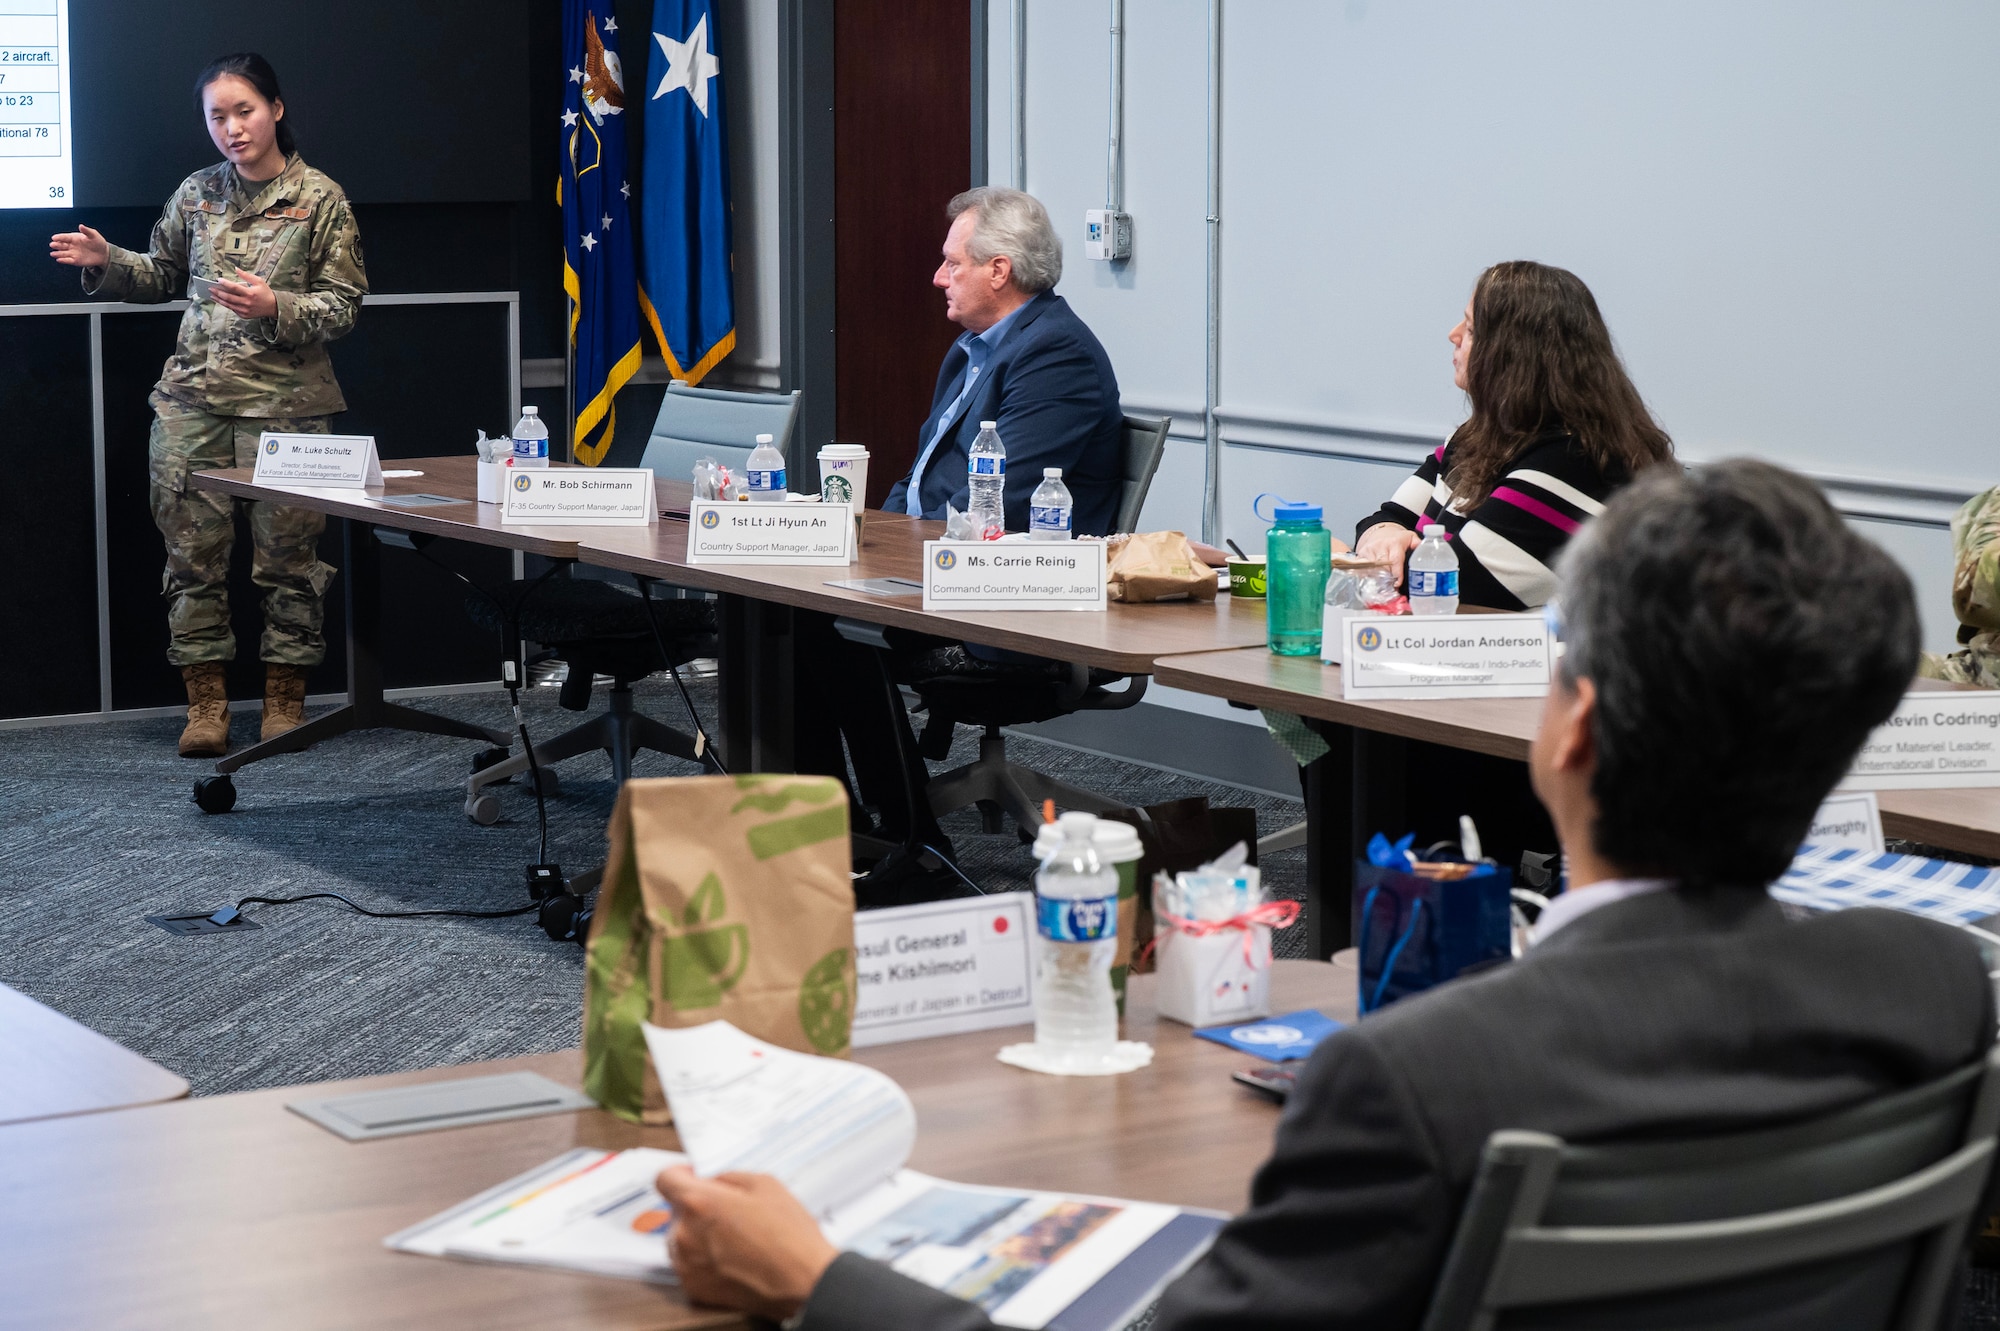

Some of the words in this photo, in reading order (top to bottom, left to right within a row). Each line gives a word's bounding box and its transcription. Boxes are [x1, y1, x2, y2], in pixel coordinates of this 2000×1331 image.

[2, 51, 9, 62] 2
[12, 51, 54, 62] aircraft.
[6, 96, 17, 106] to
[19, 96, 34, 106] 23
[0, 128, 32, 138] itional
[35, 128, 49, 138] 78
[49, 187, 65, 198] 38
[291, 445, 303, 454] Mr.
[304, 446, 322, 455] Luke
[324, 446, 352, 456] Schultz
[302, 462, 317, 470] Small
[309, 471, 342, 479] Management
[542, 480, 557, 489] Mr.
[559, 481, 579, 489] Bob
[581, 481, 633, 490] Schirmann
[528, 503, 556, 512] Country
[557, 503, 585, 512] Support
[587, 504, 619, 513] Manager,
[621, 504, 643, 513] Japan
[731, 517, 748, 527] 1st
[751, 517, 762, 527] Lt
[765, 517, 775, 527] Ji
[779, 517, 808, 530] Hyun
[811, 518, 827, 528] An
[700, 542, 734, 553] Country
[735, 542, 769, 553] Support
[771, 543, 811, 554] Manager,
[813, 543, 839, 553] Japan
[968, 556, 989, 567] Ms.
[993, 556, 1032, 567] Carrie
[1036, 556, 1076, 569] Reinig
[933, 584, 981, 594] Command
[983, 584, 1020, 595] Country
[1022, 585, 1066, 595] Manager,
[1068, 585, 1097, 595] Japan
[1386, 638, 1400, 649] Lt
[1403, 637, 1425, 649] Col
[1429, 637, 1475, 648] Jordan
[1479, 636, 1543, 647] Anderson
[1488, 659, 1543, 669] Indo-Pacific
[1410, 674, 1450, 684] Program
[1452, 674, 1494, 683] Manager
[1860, 742, 1893, 754] enior
[1857, 758, 1935, 771] International
[1938, 757, 1988, 769] Division
[857, 937, 891, 958] nsul
[895, 929, 967, 954] General
[888, 954, 976, 981] Kishimori
[857, 1004, 899, 1018] eneral
